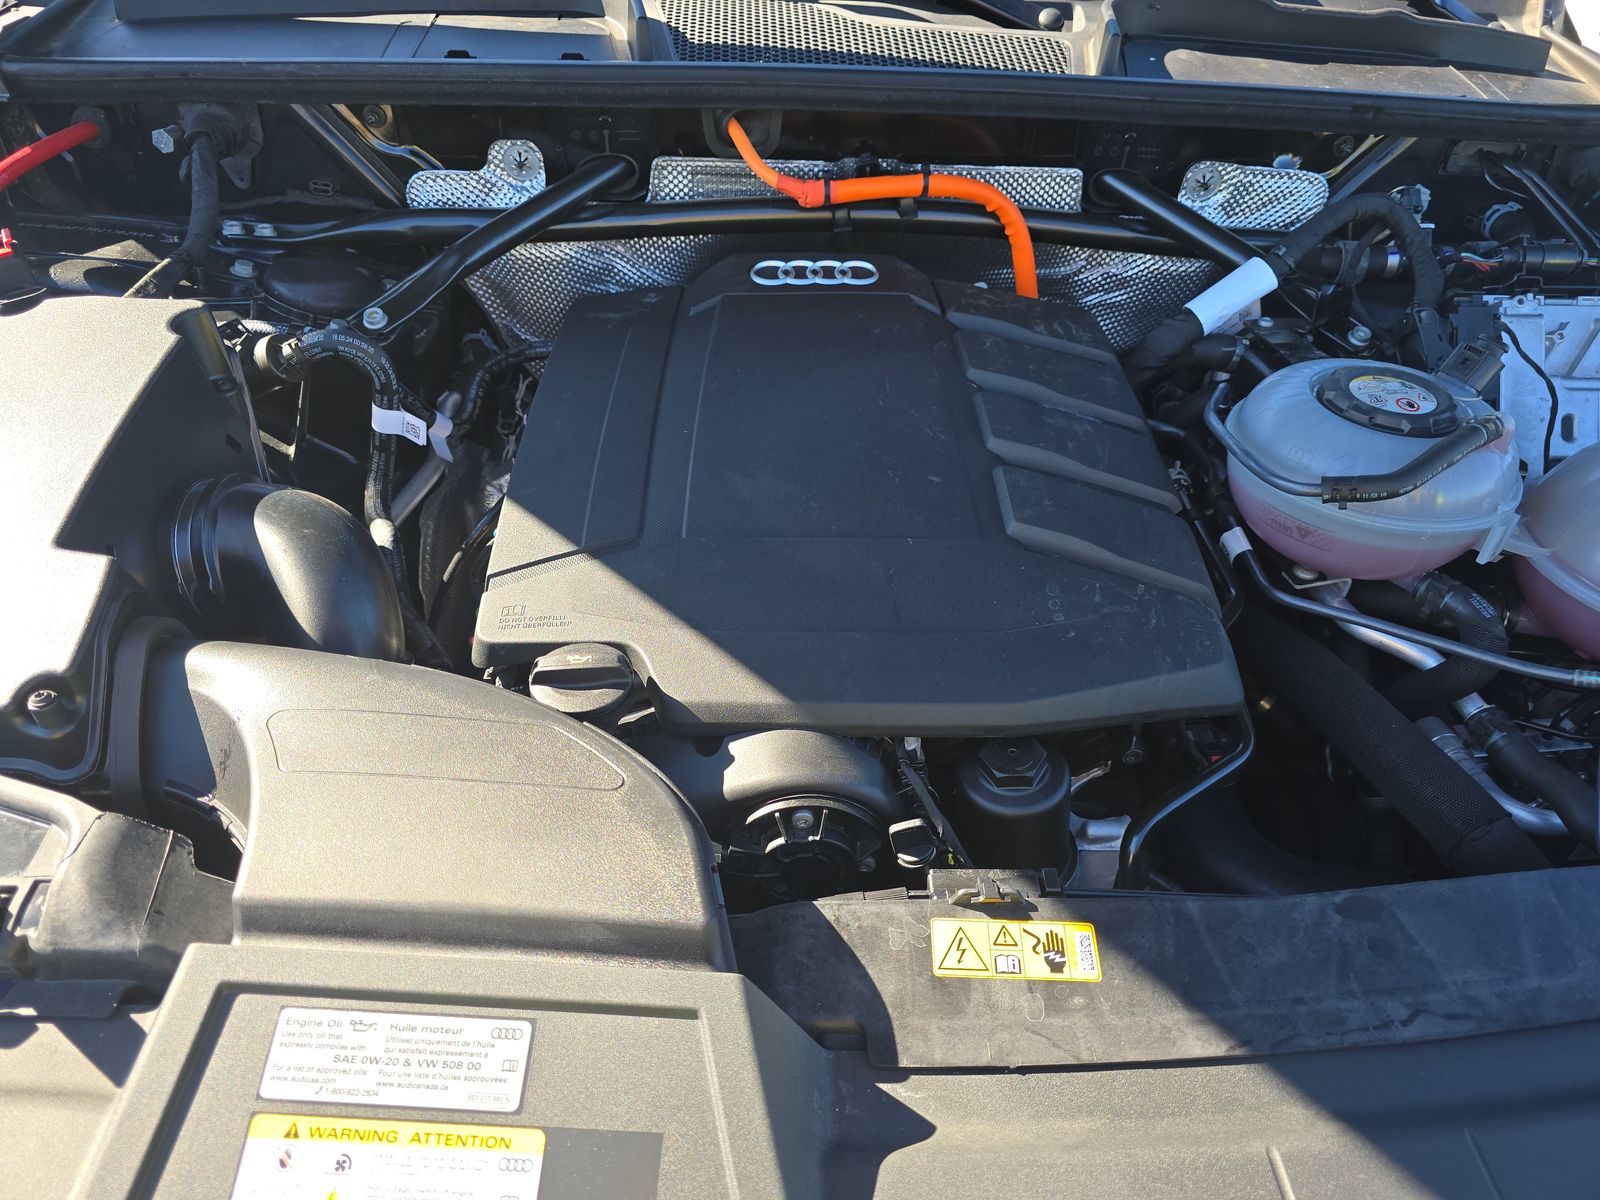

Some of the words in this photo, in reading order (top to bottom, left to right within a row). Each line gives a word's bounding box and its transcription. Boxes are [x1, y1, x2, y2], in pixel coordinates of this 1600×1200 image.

[1270, 519, 1293, 535] min
[285, 1017, 323, 1028] Engine
[327, 1019, 343, 1028] Oil
[389, 1023, 418, 1034] Huile
[421, 1026, 464, 1035] moteur
[297, 1032, 313, 1040] only
[279, 1041, 313, 1049] expressly
[315, 1043, 348, 1051] complies
[350, 1044, 366, 1052] with
[385, 1036, 413, 1044] Utilisez
[415, 1038, 460, 1048] uniquement
[384, 1047, 396, 1055] qui
[398, 1047, 427, 1056] satisfait
[333, 1054, 357, 1064] SAE
[361, 1056, 400, 1067] 0W-20
[403, 1058, 412, 1067] &
[417, 1059, 439, 1069] VW
[442, 1061, 463, 1070] 508
[467, 1062, 482, 1071] 00
[272, 1063, 285, 1071] For
[293, 1064, 304, 1072] list
[316, 1067, 352, 1075] approved
[378, 1069, 396, 1078] Pour
[269, 1075, 337, 1084] www.audiusa.com
[376, 1081, 449, 1091] www.audicanada.ca
[309, 1126, 399, 1143] WARNING
[409, 1132, 512, 1149] ATTENTION
